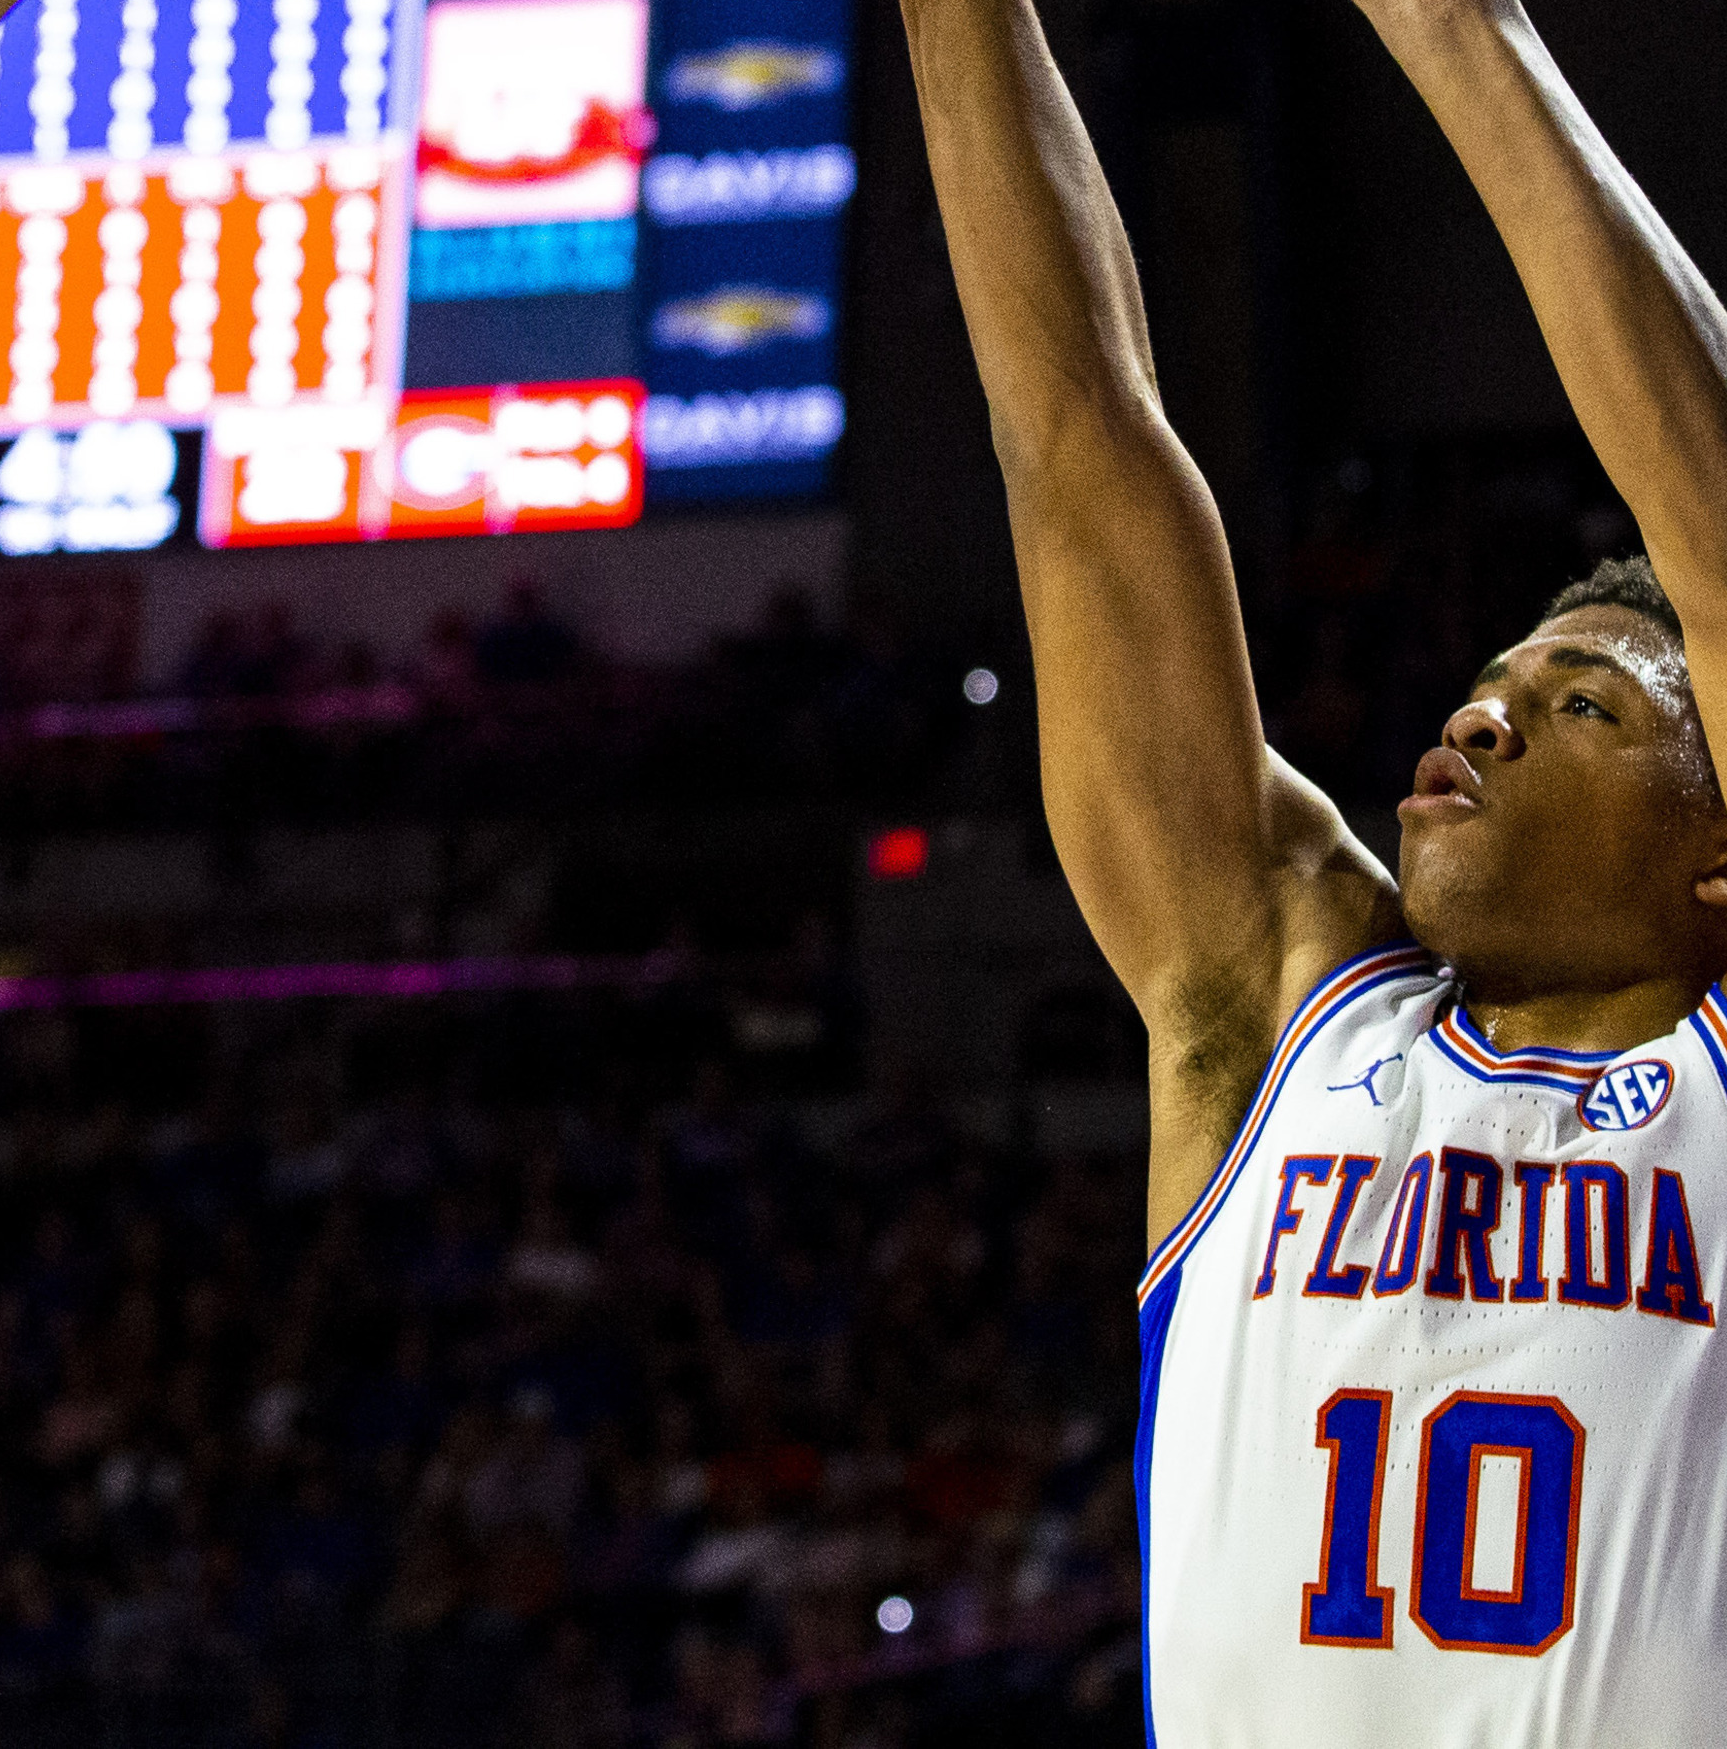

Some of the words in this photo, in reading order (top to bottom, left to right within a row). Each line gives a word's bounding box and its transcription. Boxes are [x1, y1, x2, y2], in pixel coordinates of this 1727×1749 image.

[1585, 1063, 1667, 1130] SEC
[1253, 1146, 1715, 1328] FLORIDA
[1300, 1388, 1586, 1658] 10
